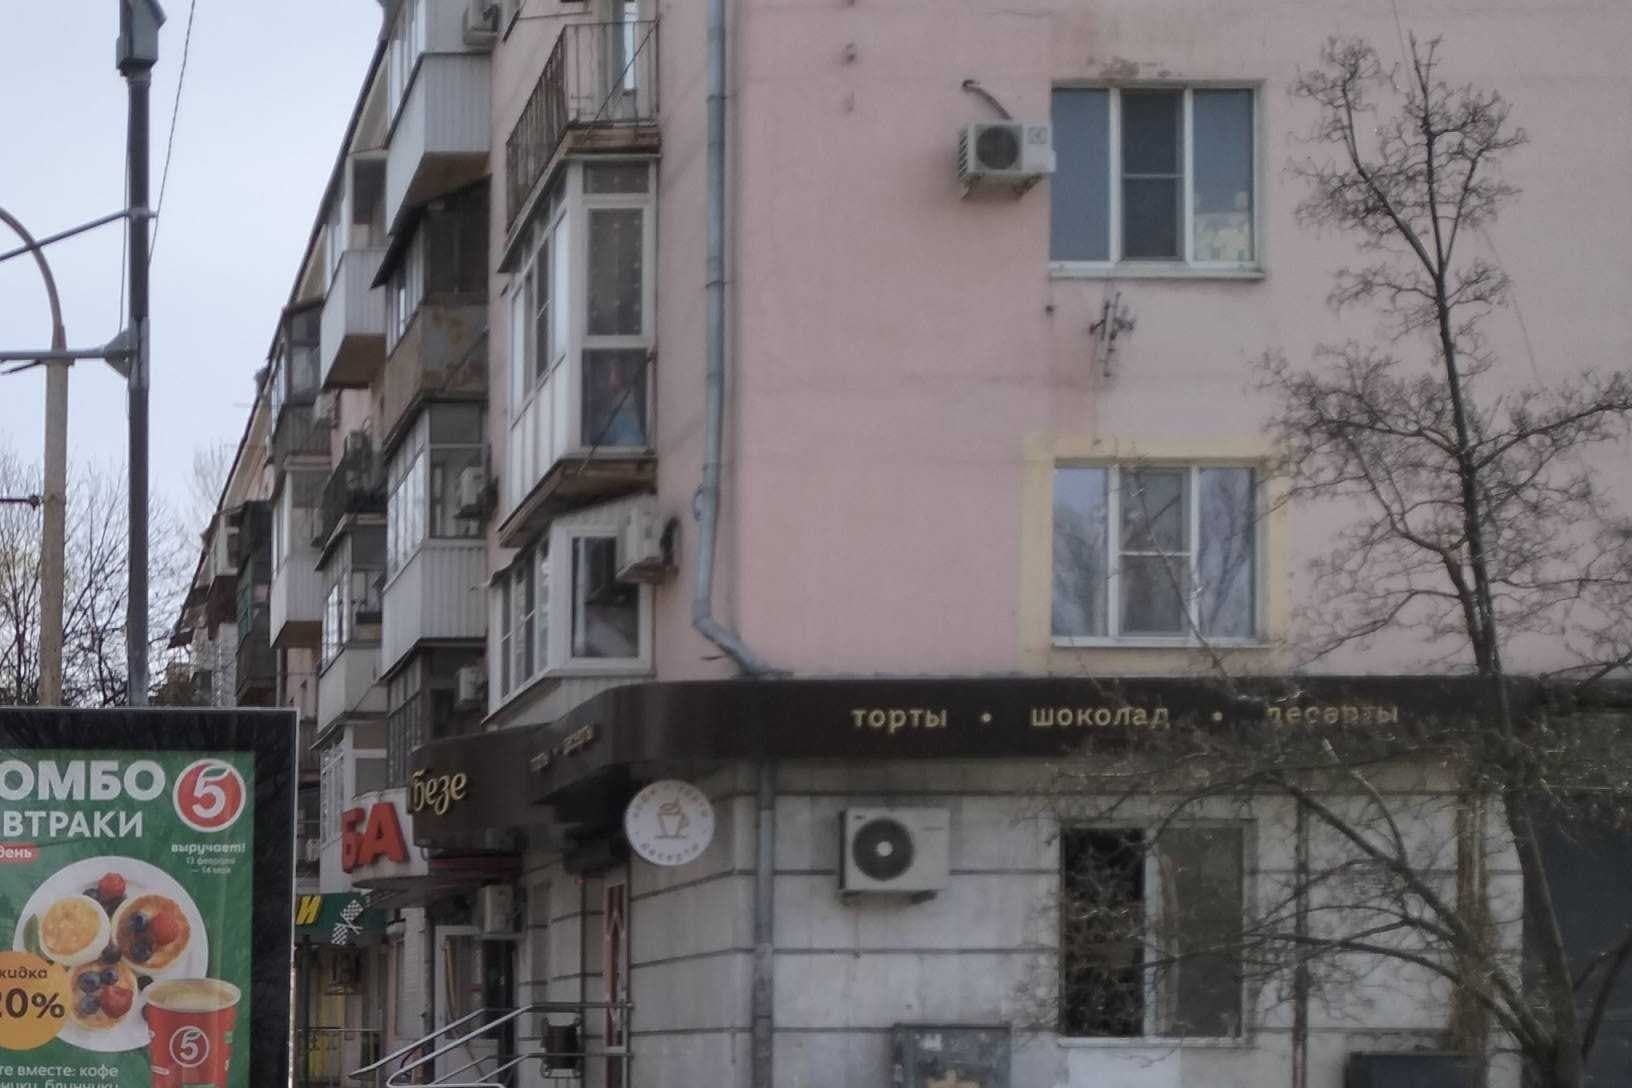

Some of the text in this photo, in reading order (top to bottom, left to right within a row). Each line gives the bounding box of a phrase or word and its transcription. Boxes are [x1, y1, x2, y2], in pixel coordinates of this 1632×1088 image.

[852, 708, 948, 734] торты
[1031, 705, 1170, 729] шоколад
[17, 1065, 77, 1077] вместе:
[79, 1064, 119, 1080] кофе
